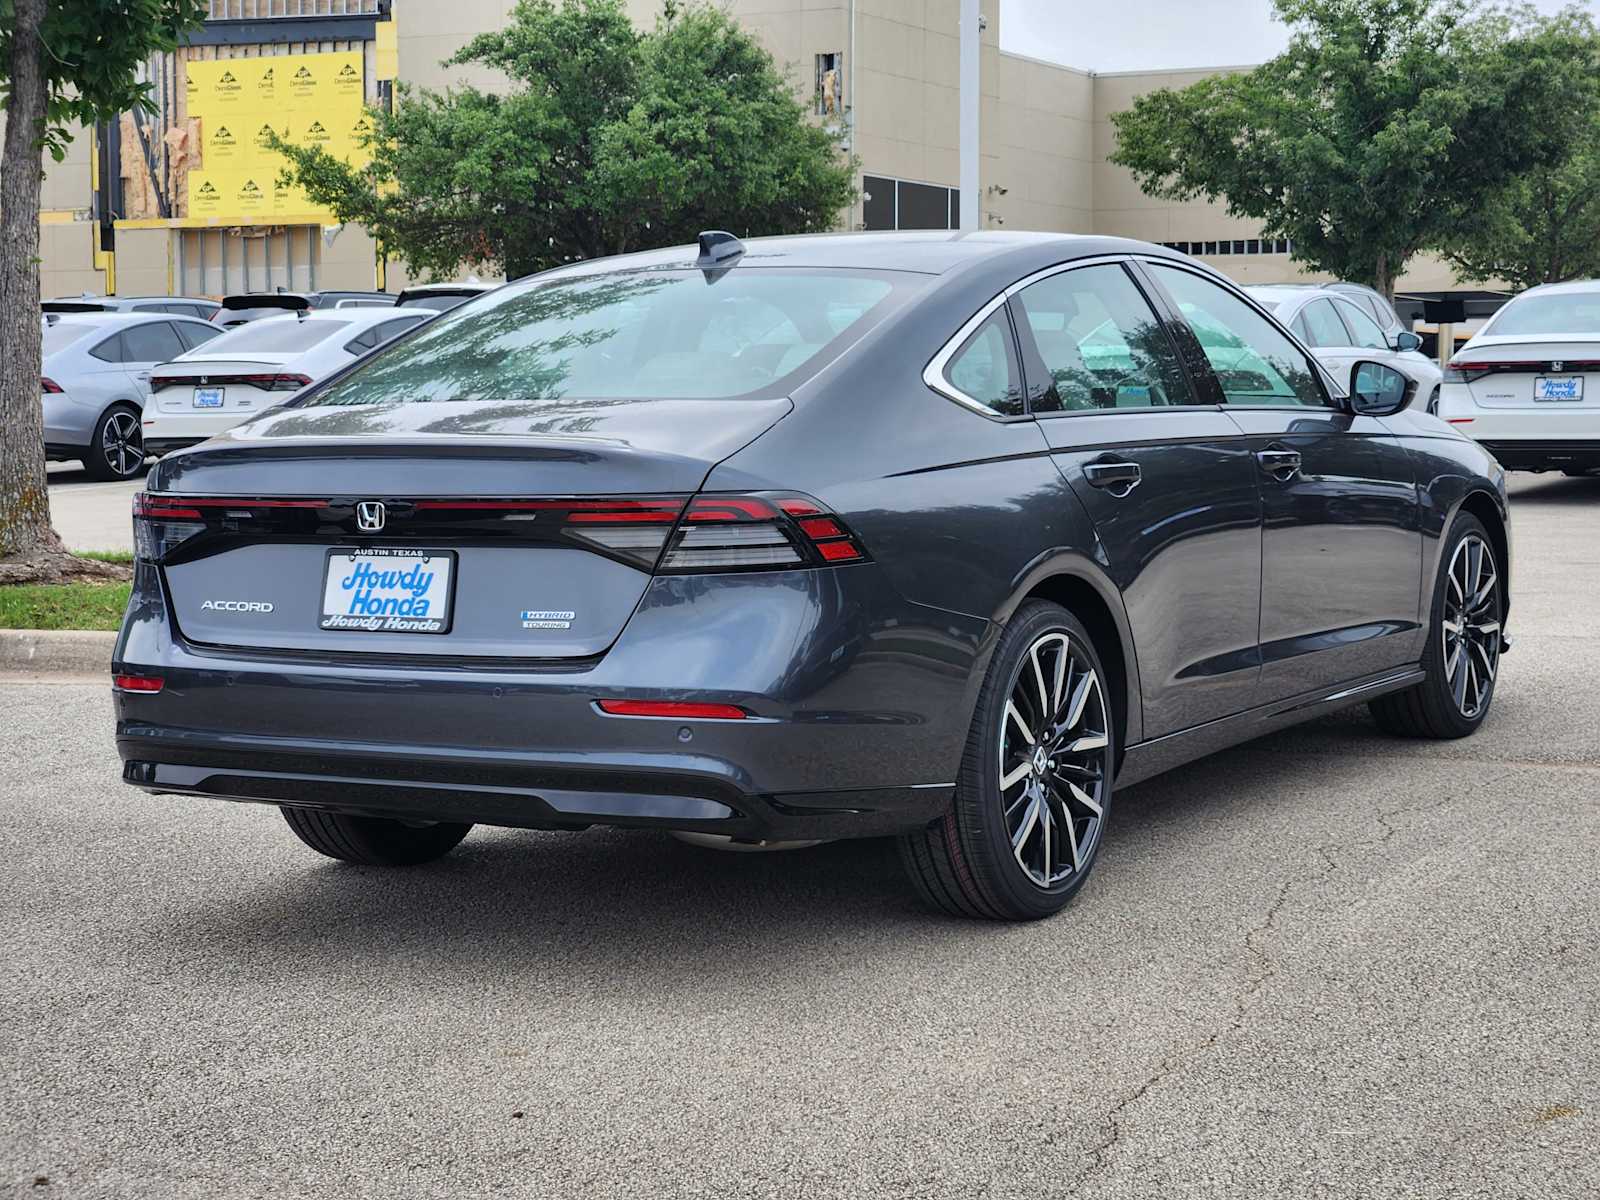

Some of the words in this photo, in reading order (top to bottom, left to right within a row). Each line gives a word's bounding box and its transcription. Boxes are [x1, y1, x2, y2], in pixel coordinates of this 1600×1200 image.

[1545, 388, 1576, 397] Honda
[354, 548, 389, 556] AUSTIN
[392, 549, 424, 557] TEXAS
[342, 562, 434, 597] Howdy
[201, 600, 274, 612] ACCORD
[349, 589, 430, 617] Honda
[528, 611, 572, 619] HYBRID
[322, 615, 384, 631] Howdy
[384, 617, 441, 631] Honda
